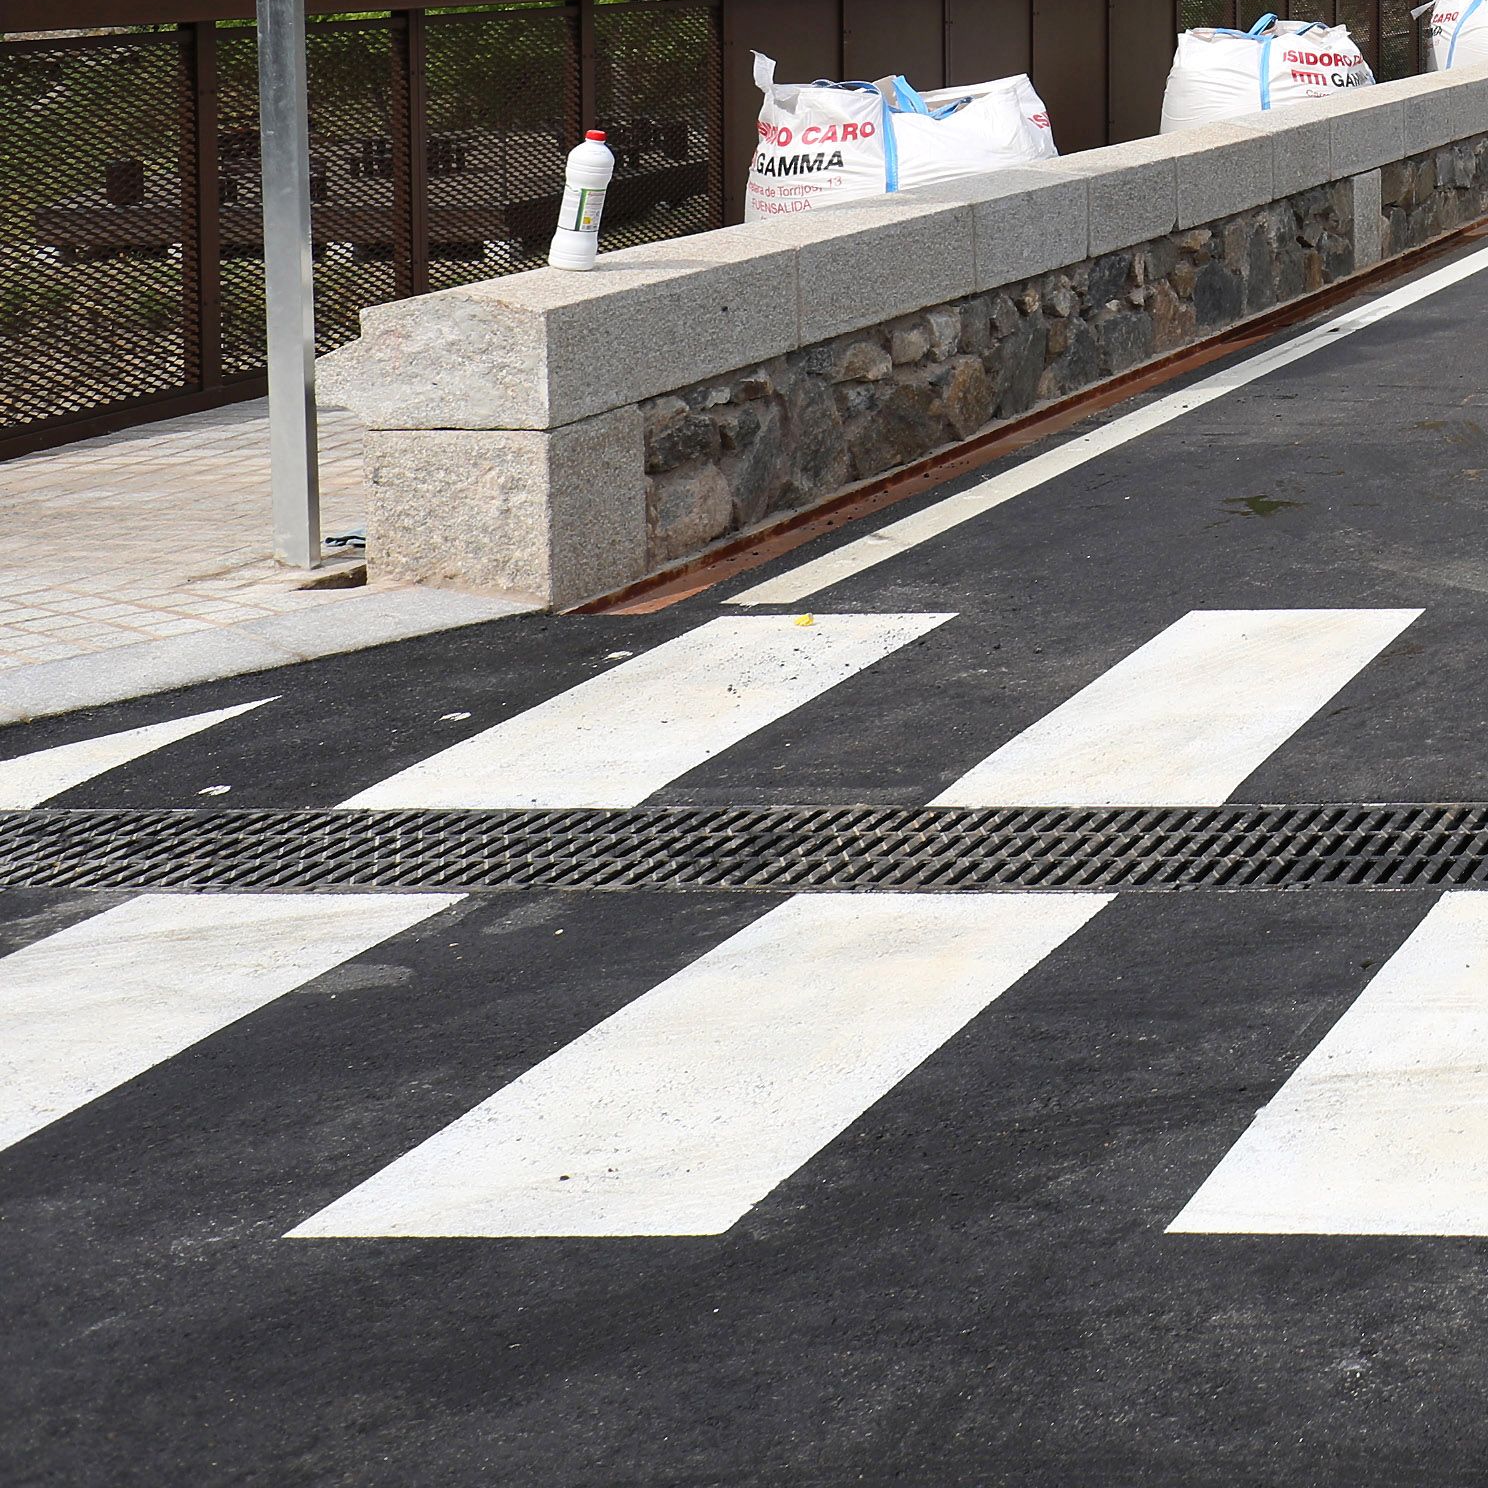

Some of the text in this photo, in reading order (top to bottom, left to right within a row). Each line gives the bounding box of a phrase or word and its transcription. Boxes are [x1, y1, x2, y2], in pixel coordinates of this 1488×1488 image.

[1433, 11, 1459, 23] CARO
[801, 121, 876, 145] CARO
[756, 151, 844, 178] GAMMA
[765, 186, 776, 198] de
